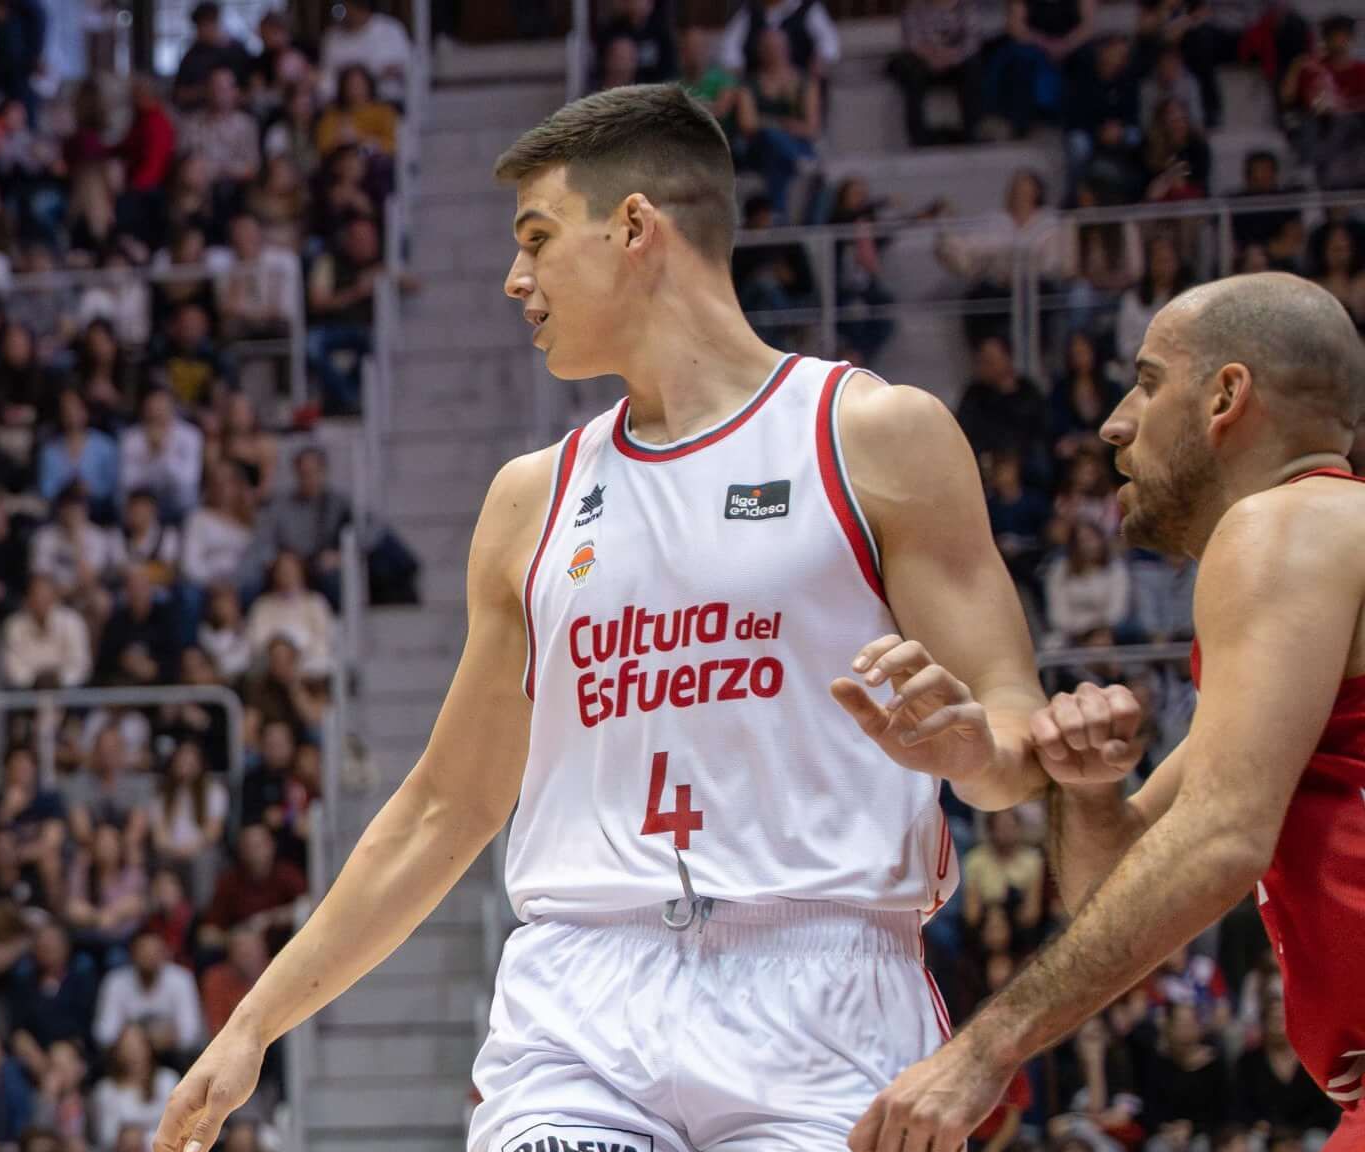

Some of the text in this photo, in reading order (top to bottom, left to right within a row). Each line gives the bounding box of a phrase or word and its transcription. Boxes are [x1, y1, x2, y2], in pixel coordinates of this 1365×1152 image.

[729, 503, 786, 517] endesa
[731, 494, 758, 507] liga
[570, 602, 781, 669] Cultura del
[576, 656, 783, 727] Esfuerzo
[640, 751, 703, 850] 4
